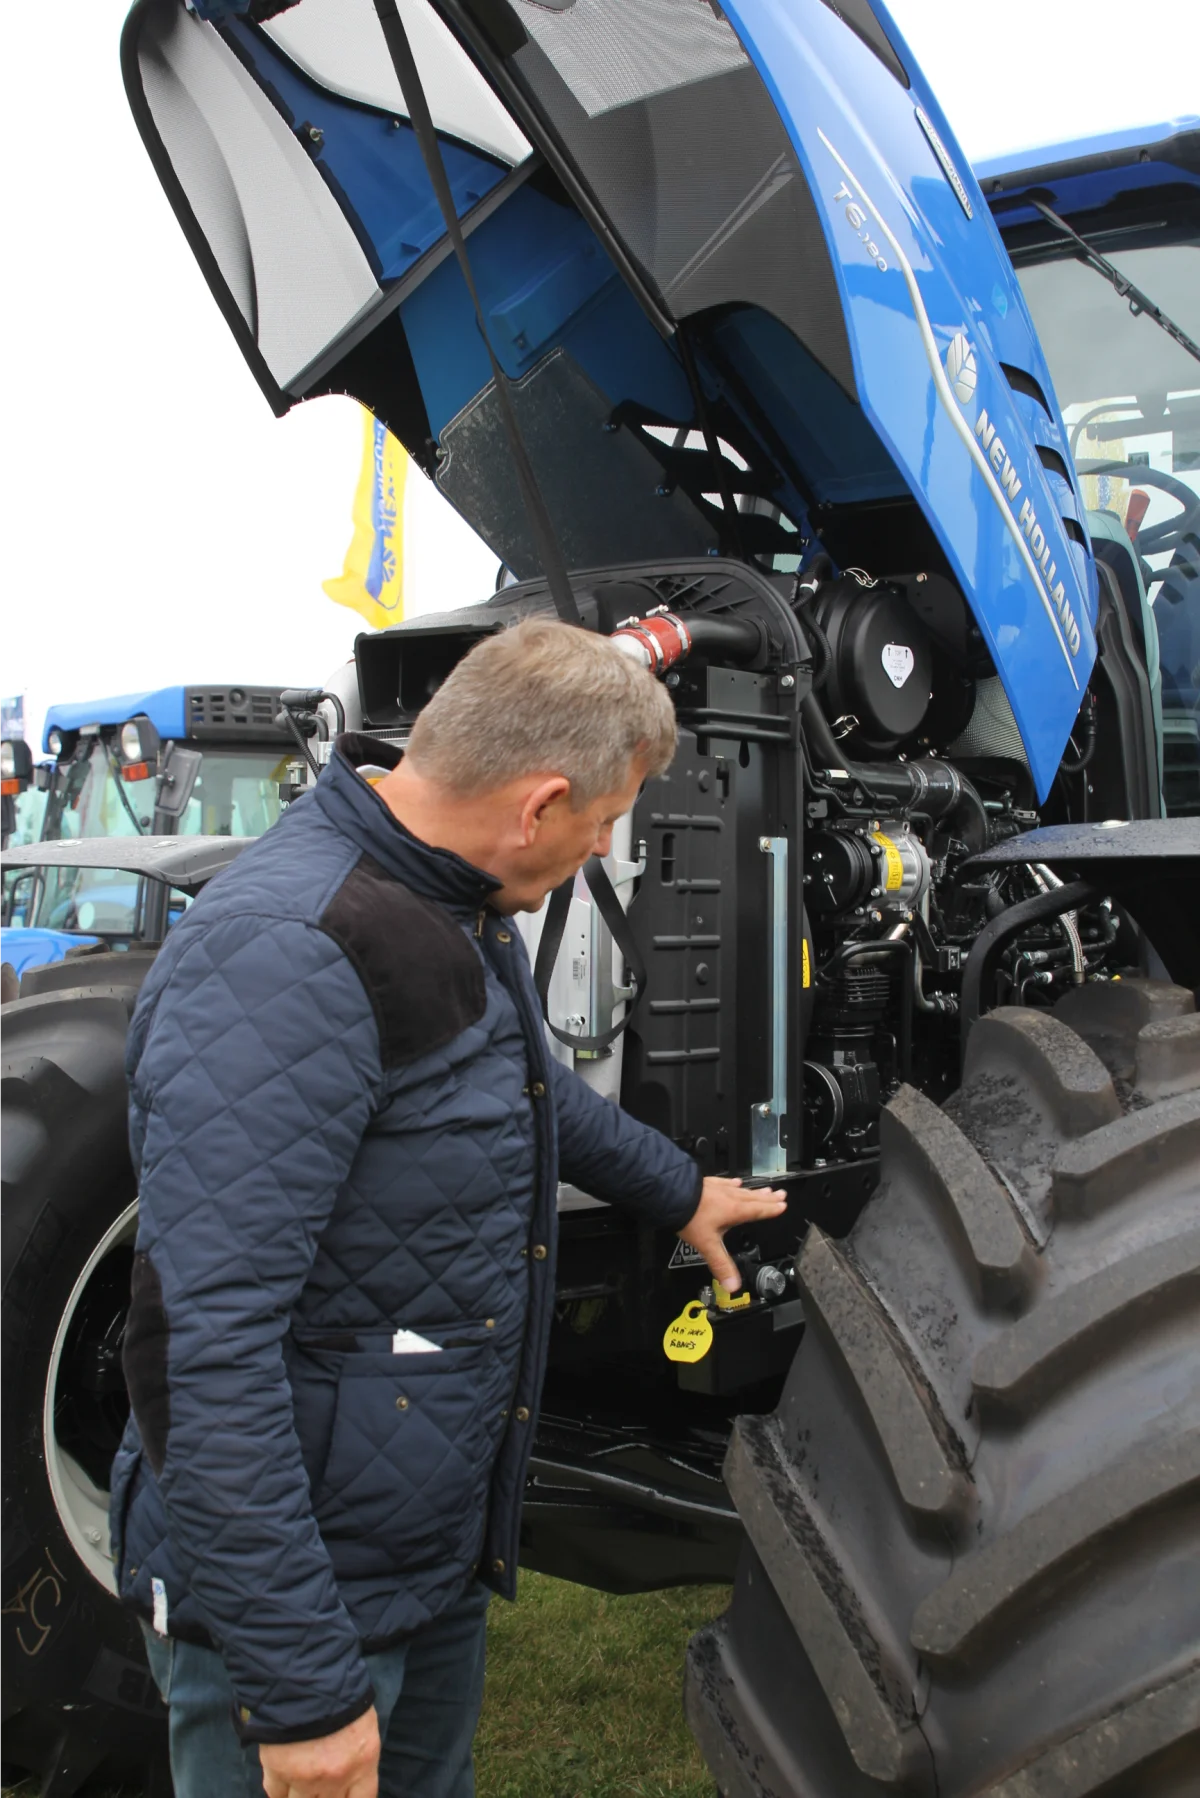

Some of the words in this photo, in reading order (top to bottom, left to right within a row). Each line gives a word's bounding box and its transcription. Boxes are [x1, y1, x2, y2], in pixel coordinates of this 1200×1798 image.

[833, 181, 888, 272] T6.180
[974, 408, 1022, 502] NEW
[1019, 497, 1081, 658] HOLLAND
